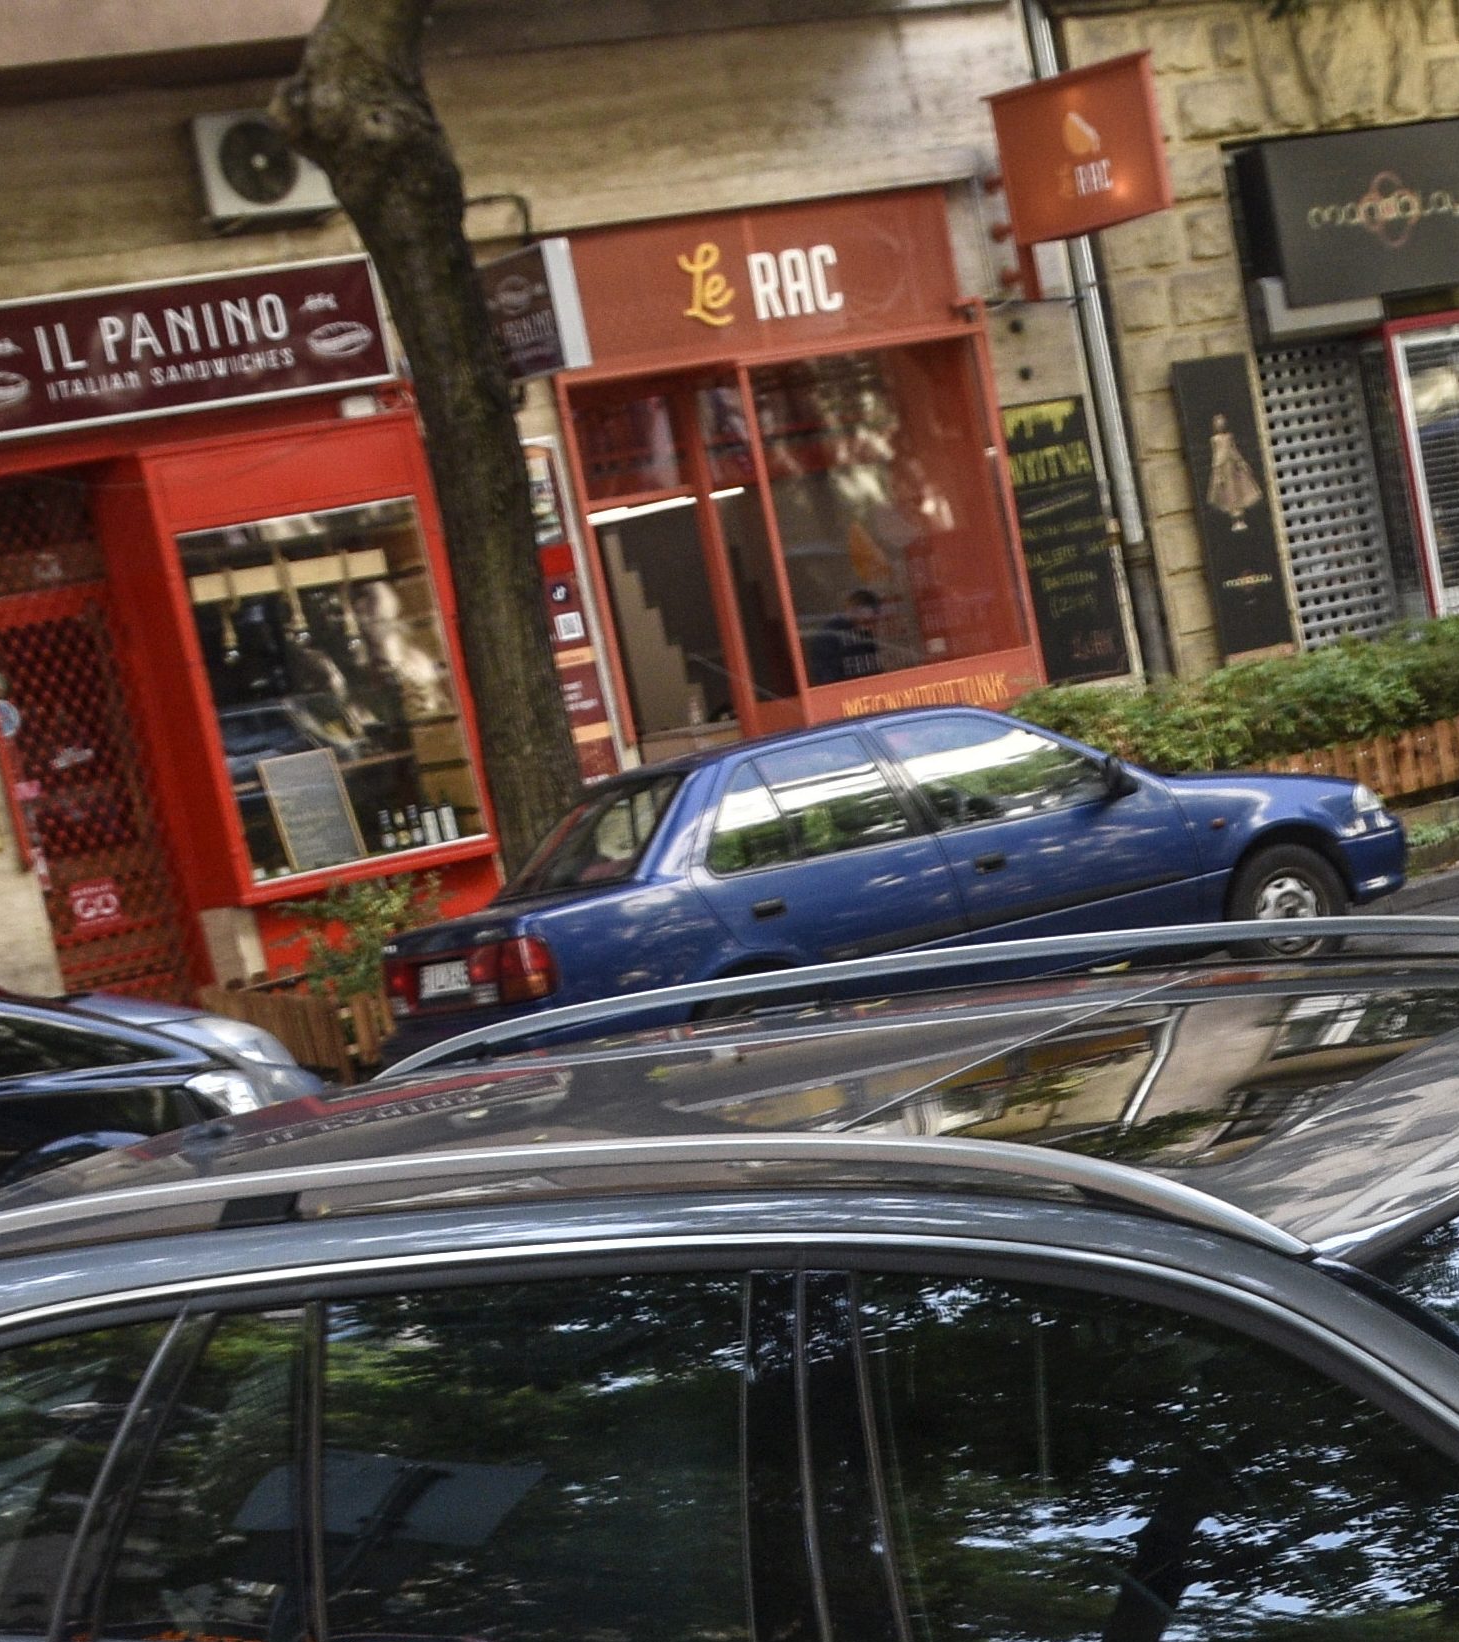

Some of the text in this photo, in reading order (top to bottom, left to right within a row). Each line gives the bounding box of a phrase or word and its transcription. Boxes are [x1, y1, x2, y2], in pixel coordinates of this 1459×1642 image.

[677, 242, 844, 327] Le RAC
[34, 292, 291, 373] IL PANINO
[45, 347, 297, 402] ITALIAN SANDWICHES
